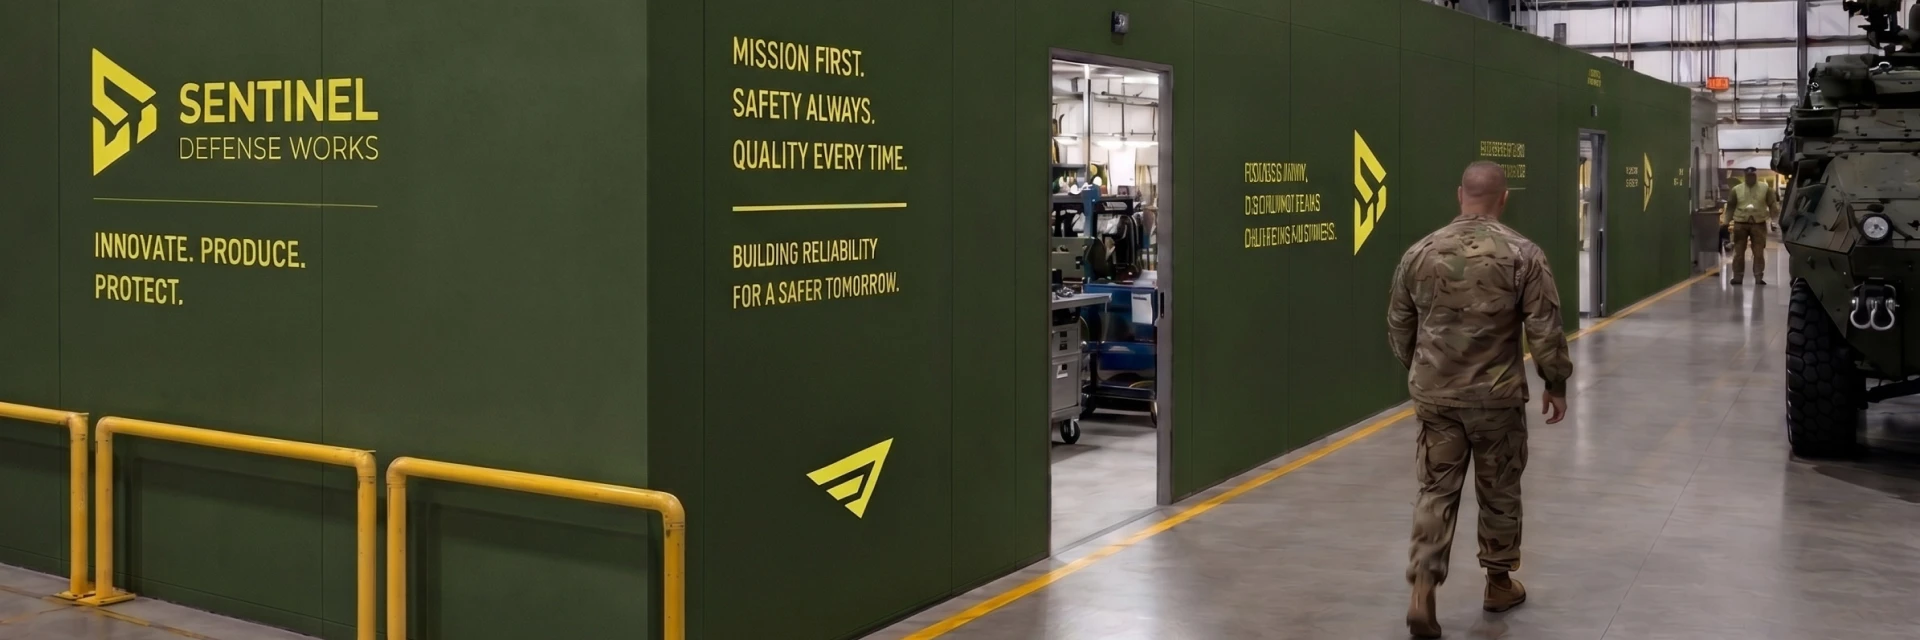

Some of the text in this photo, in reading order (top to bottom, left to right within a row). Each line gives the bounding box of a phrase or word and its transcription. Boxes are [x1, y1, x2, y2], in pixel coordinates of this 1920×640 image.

[733, 36, 865, 77] MISSION FIRST.
[179, 77, 379, 124] SENTINEL
[733, 88, 875, 125] SAFETY ALWAYS.
[180, 135, 379, 160] DEFENSE WORKS
[733, 139, 907, 171] QUALITY EVERY TIME.
[95, 231, 306, 268] INNOVATE. PRODUCE.
[733, 238, 878, 269] BUILDING RELIABILITY
[733, 272, 900, 309] FOR A SAFER TOMORROW.
